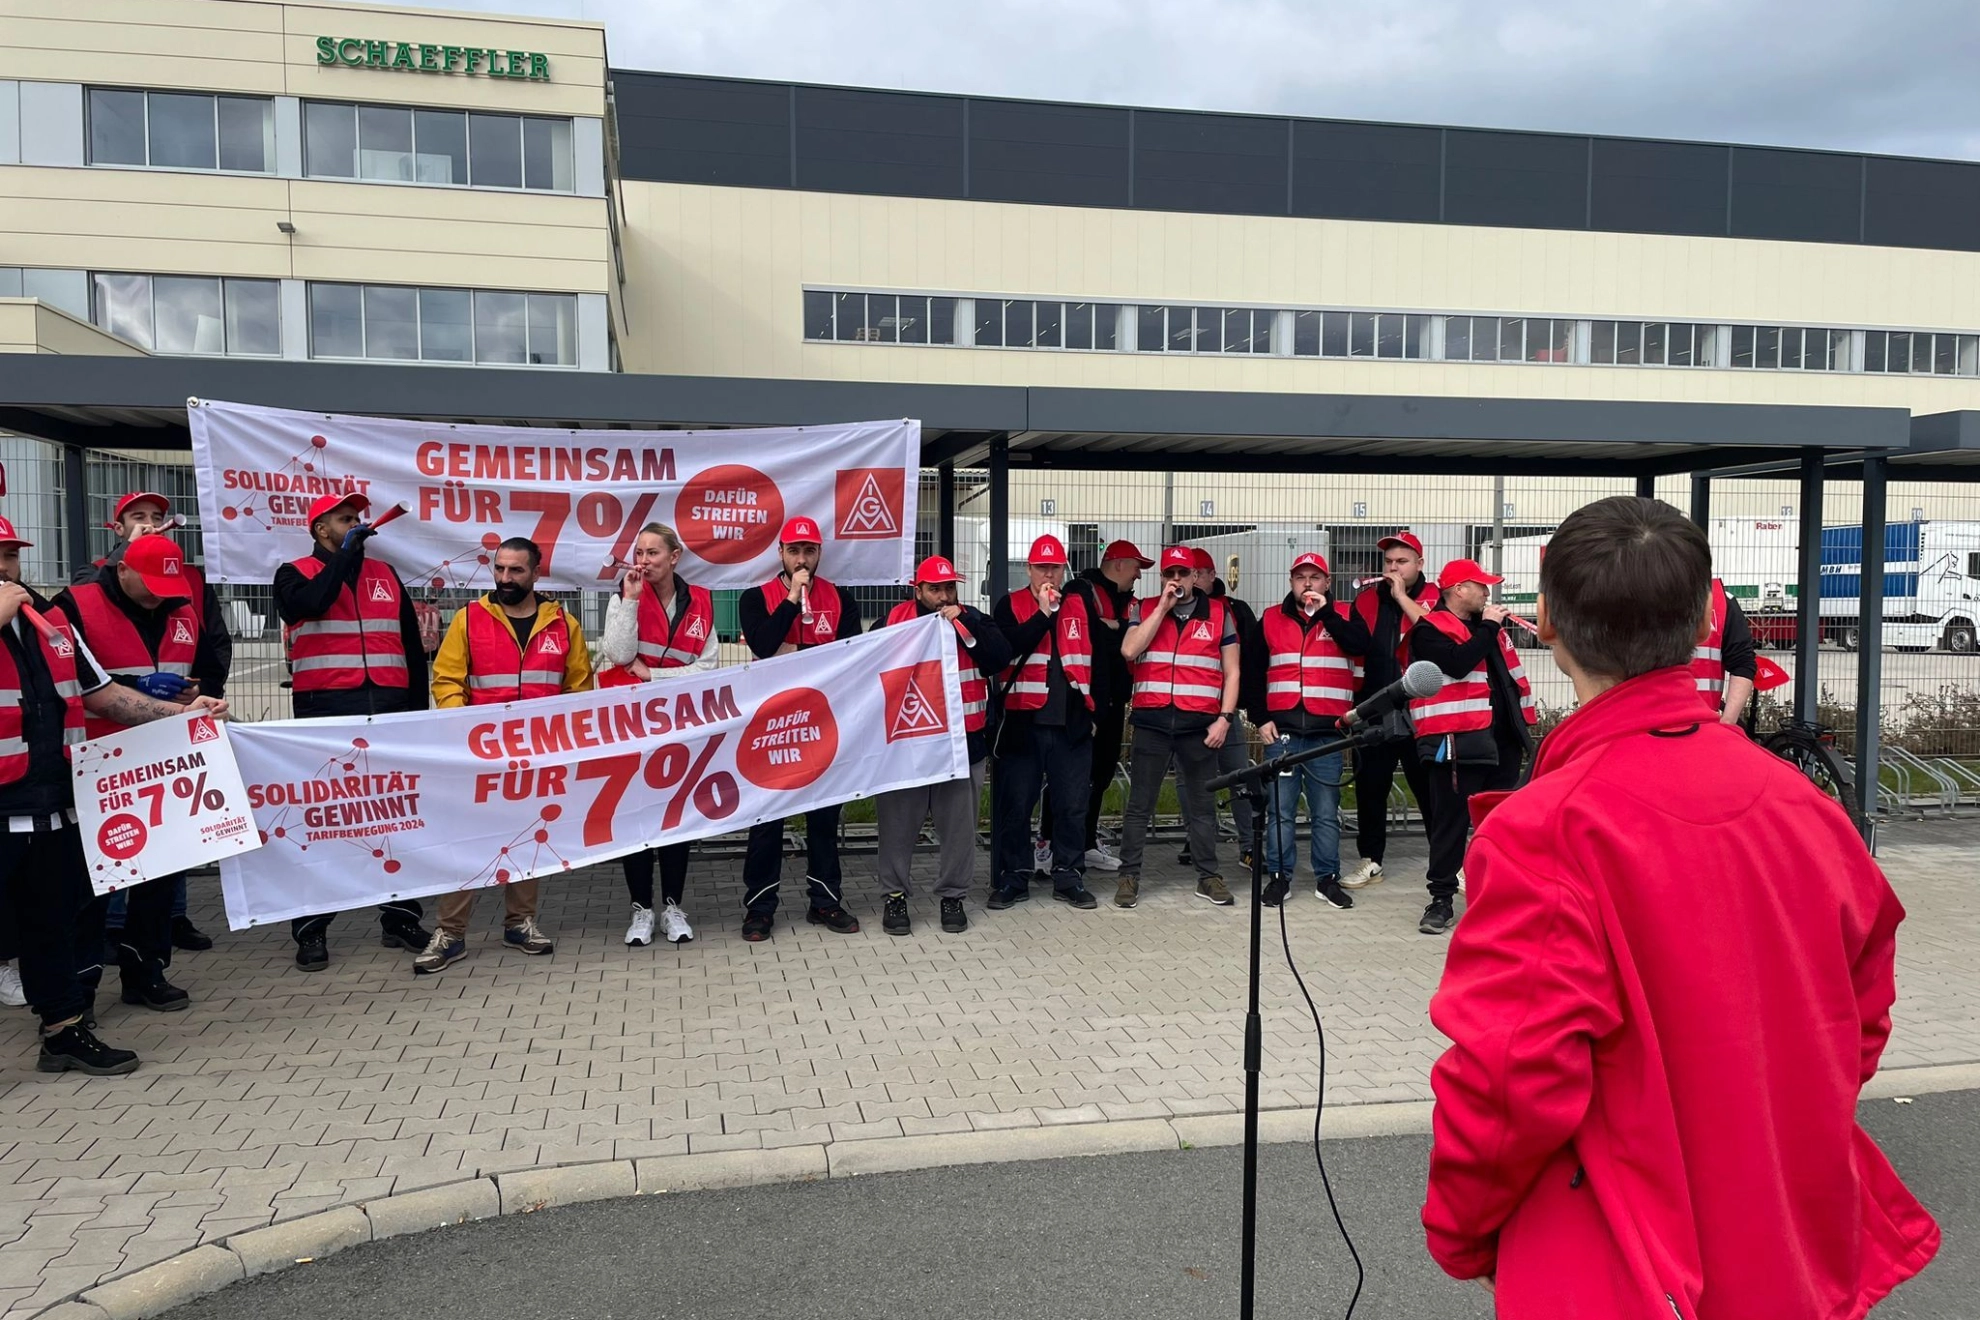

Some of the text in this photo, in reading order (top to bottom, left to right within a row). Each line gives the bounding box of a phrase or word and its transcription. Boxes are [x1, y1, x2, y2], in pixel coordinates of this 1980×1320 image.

[316, 36, 549, 78] SCHAEFFLER
[416, 441, 677, 482] GEMEINSAM
[223, 469, 371, 497] SOLIDARITÄT
[419, 480, 503, 523] FÜR
[704, 488, 757, 505] DAFÜR
[691, 506, 768, 524] STREITEN
[1042, 501, 1054, 515] 13
[1201, 502, 1212, 516] 14
[1354, 504, 1365, 516] 15
[1503, 505, 1513, 517] 16
[712, 525, 744, 541] WIR
[467, 684, 742, 760] GEMEINSAM
[766, 710, 811, 731] DAFÜR
[751, 726, 821, 751] STREITEN
[767, 748, 802, 765] WIR
[96, 751, 206, 794] GEMEINSAM
[247, 770, 421, 808] SOLIDARITÄT
[474, 731, 740, 847] FÜR 7%
[99, 791, 134, 814] FÜR
[304, 793, 420, 828] GEWINNT
[107, 822, 132, 837] DAFÜR
[200, 816, 246, 834] SOLIDARITÄT
[215, 823, 248, 837] GEWINNT
[305, 818, 425, 842] TARIFBEWEGUNG 2024
[105, 828, 140, 847] STREITEN
[116, 839, 135, 851] WIR!
